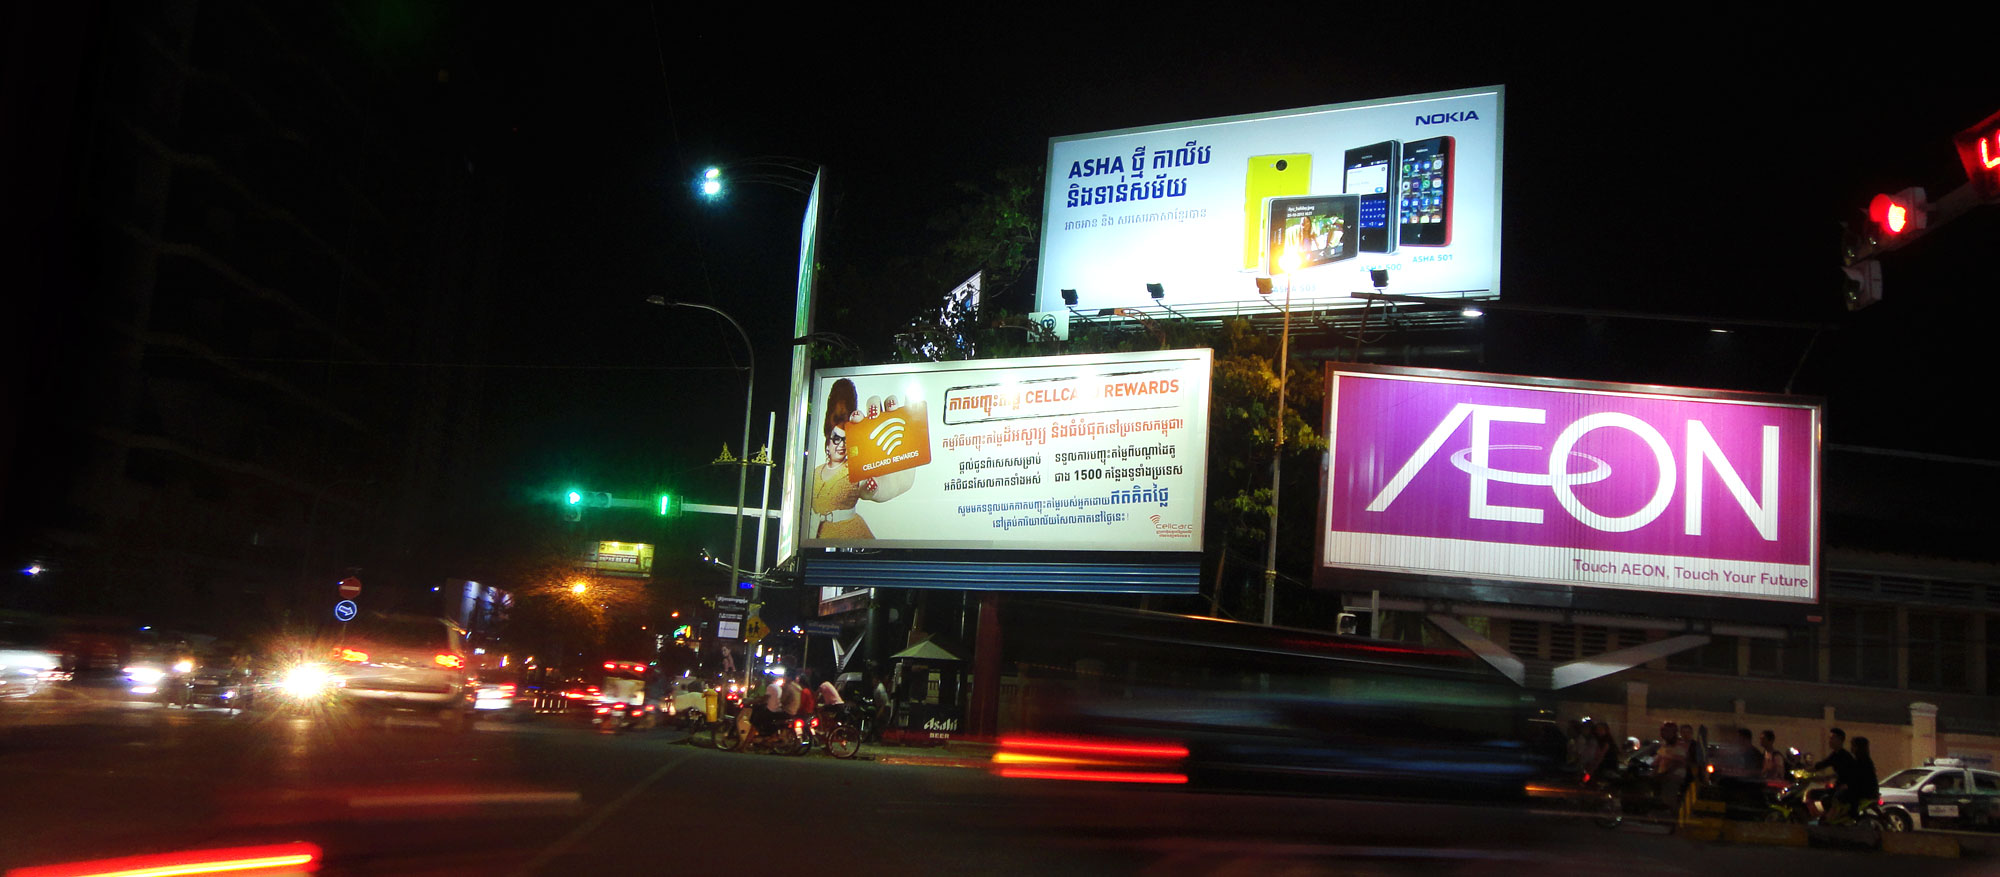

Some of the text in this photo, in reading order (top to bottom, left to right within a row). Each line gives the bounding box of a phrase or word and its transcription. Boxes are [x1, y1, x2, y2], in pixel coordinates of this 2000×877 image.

[1415, 110, 1480, 126] NOKIA
[1068, 155, 1125, 179] ASHA
[1131, 145, 1146, 178] ថ្មី
[1066, 173, 1188, 208] និងទាន់សម័យ
[1101, 213, 1114, 227] និង
[1412, 254, 1453, 263] ASHA 501
[1025, 384, 1100, 404] CELLCA
[1104, 379, 1180, 398] REWARDS
[862, 450, 919, 471] CELLCARD REWARDS
[1055, 471, 1071, 482] ជាង
[1074, 469, 1102, 481] 1500
[1573, 558, 1809, 588] Touch AEON, Touch Your Future
[923, 717, 958, 731] Asahi
